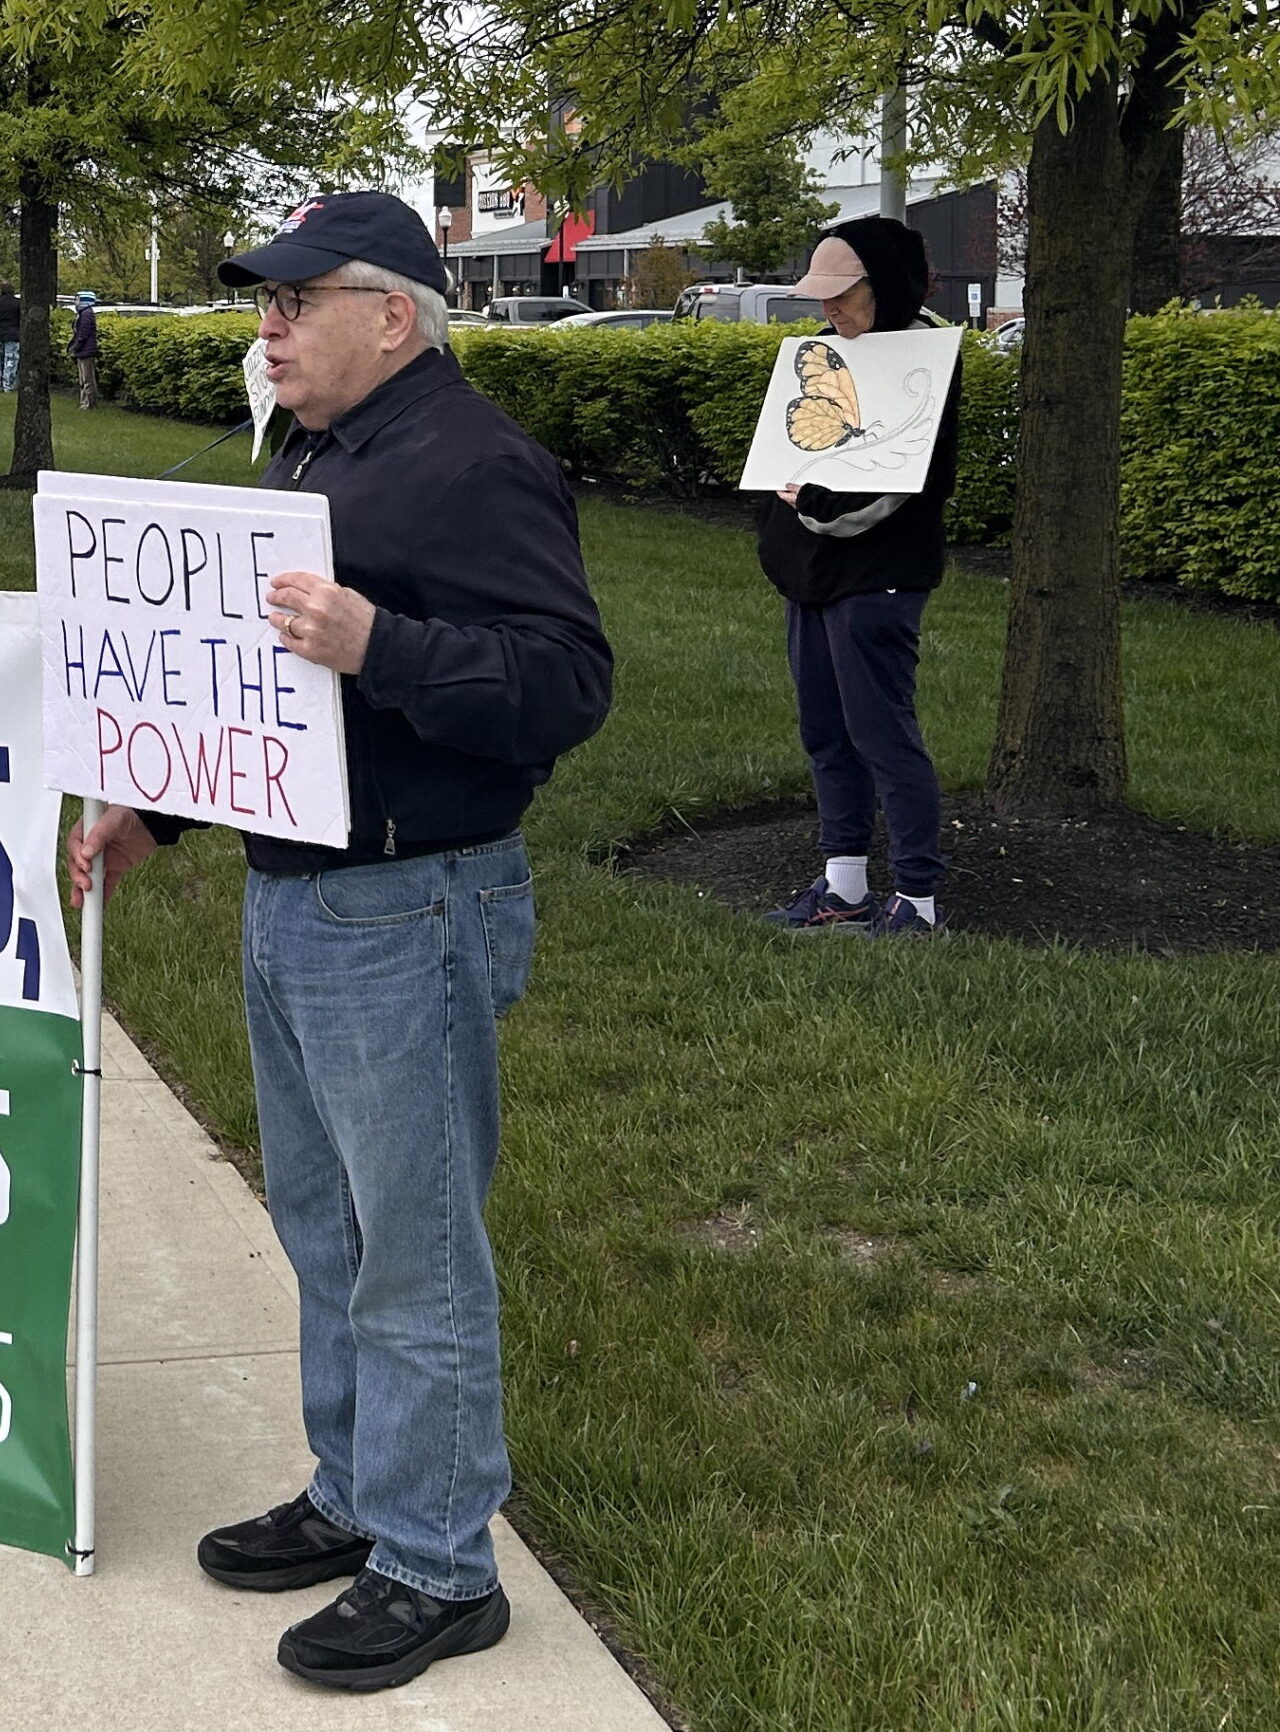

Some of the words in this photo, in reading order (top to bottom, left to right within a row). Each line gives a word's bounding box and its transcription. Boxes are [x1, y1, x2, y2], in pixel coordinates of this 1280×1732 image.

[65, 510, 275, 620] PEOPLE
[61, 619, 188, 706] HAVE
[200, 637, 308, 730] THE
[96, 706, 298, 827] POWER
